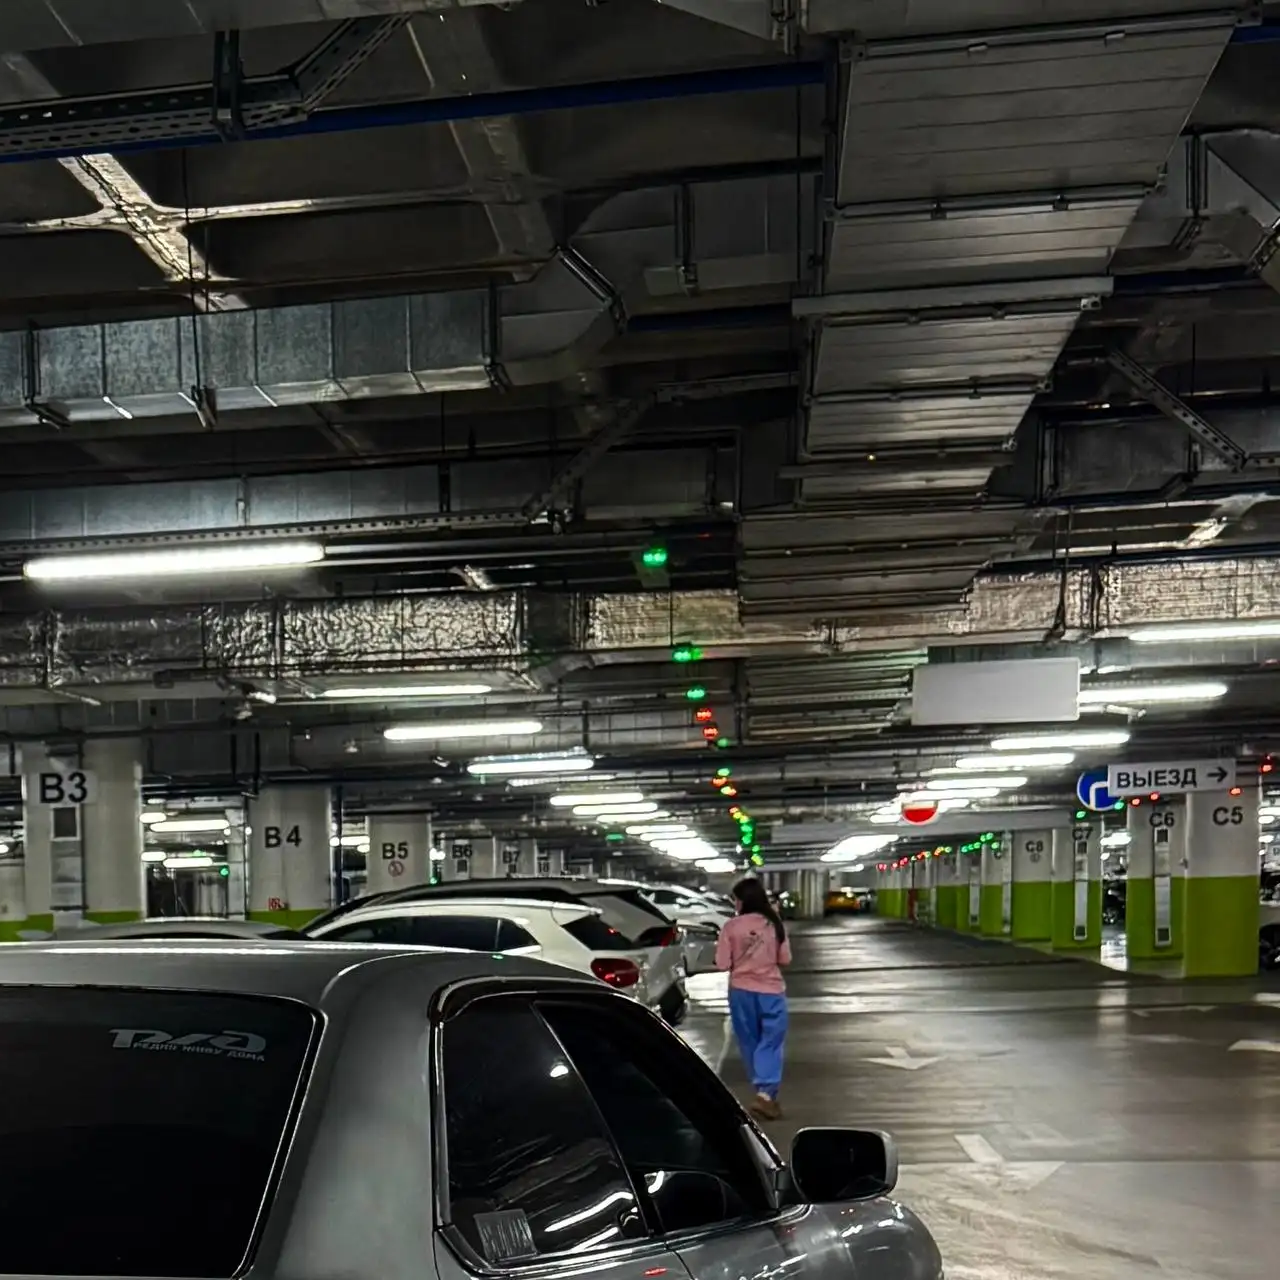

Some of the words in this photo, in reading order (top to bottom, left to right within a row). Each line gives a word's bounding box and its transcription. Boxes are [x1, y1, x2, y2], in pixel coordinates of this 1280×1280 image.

[1116, 767, 1198, 789] ВЫЕЗД
[40, 774, 88, 803] B3
[1149, 812, 1176, 828] C6
[1213, 806, 1244, 826] C5
[265, 827, 302, 848] B4
[382, 843, 409, 860] B5
[452, 844, 473, 859] B6
[227, 1051, 265, 1062] ДОМА
